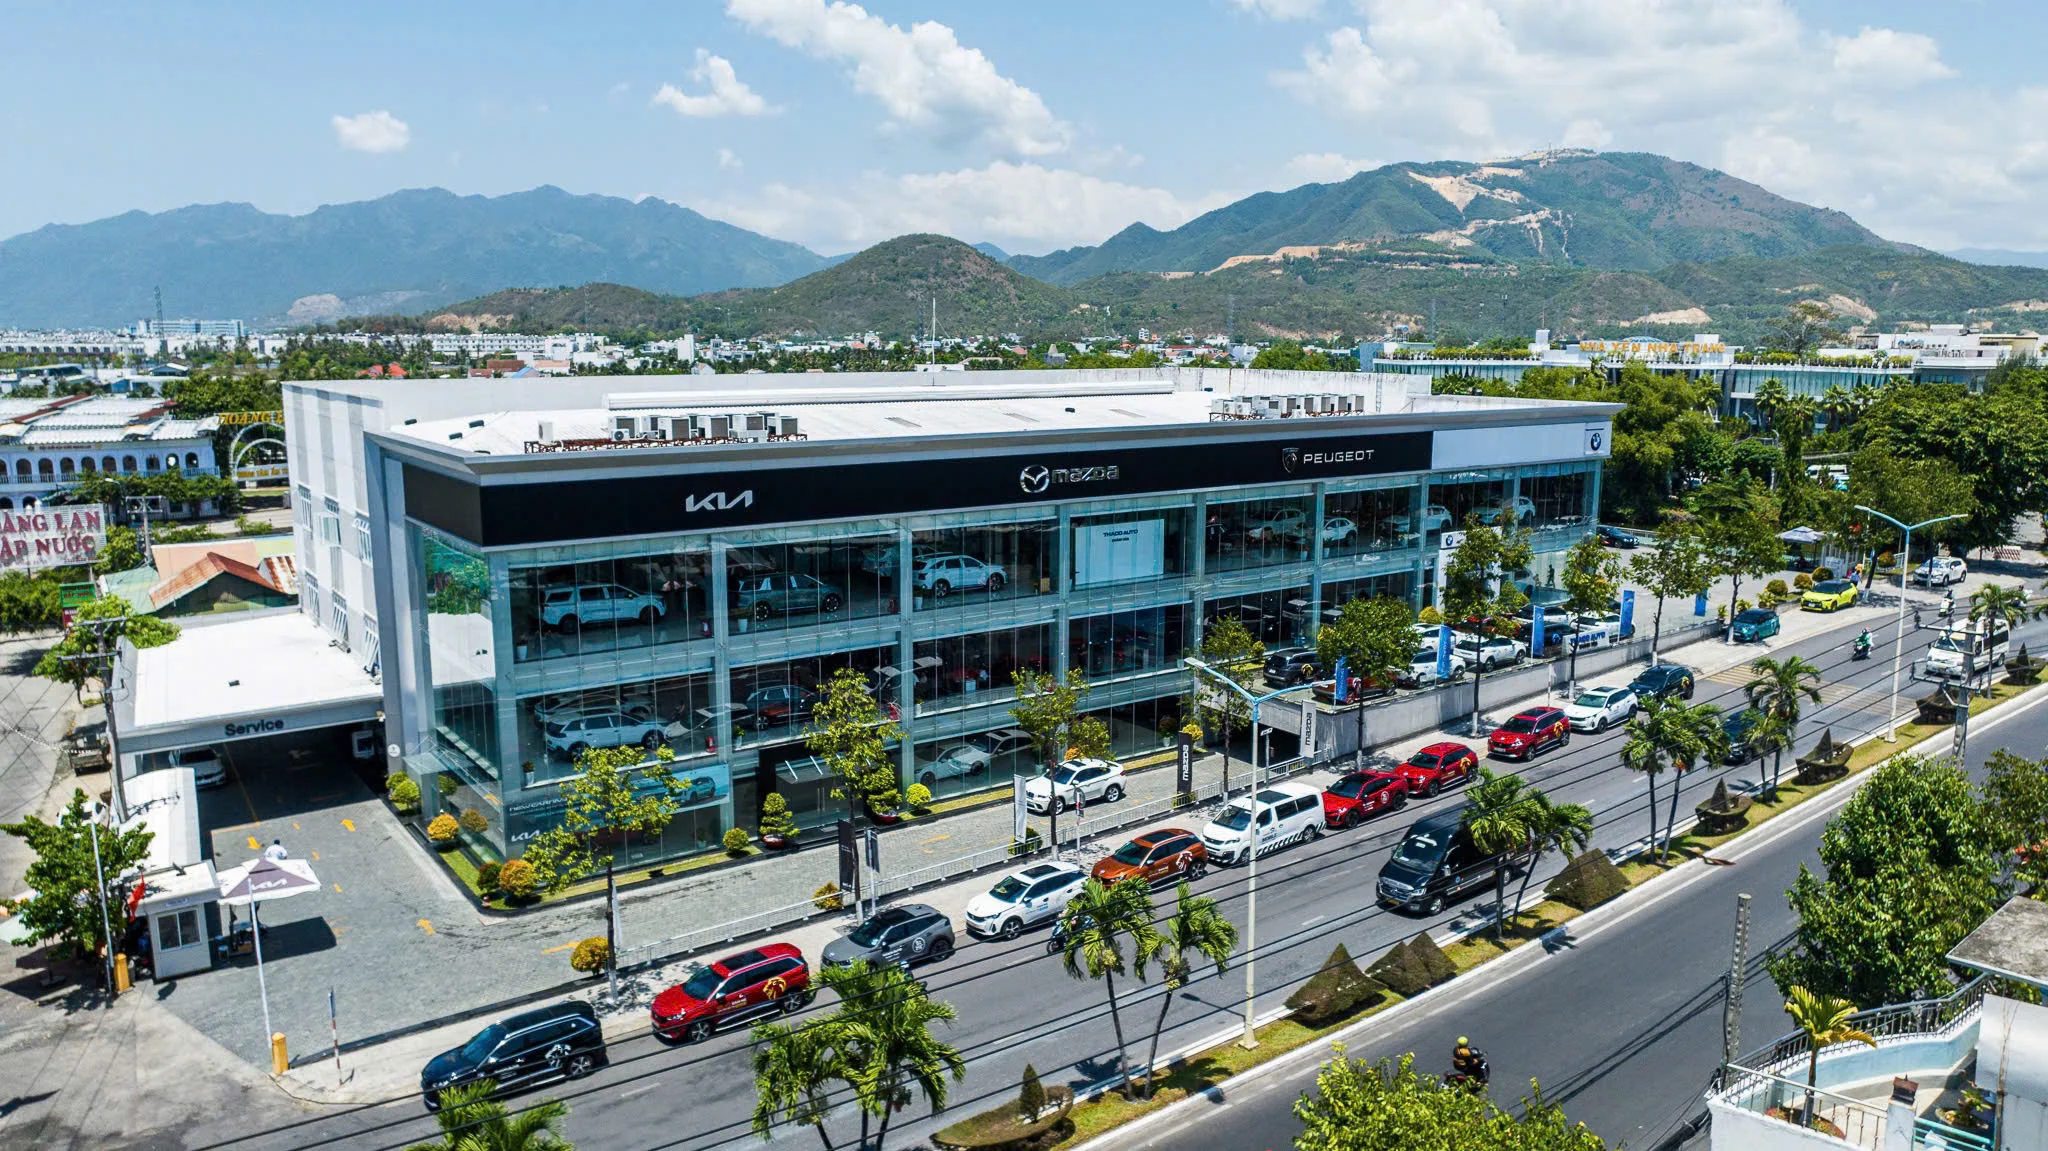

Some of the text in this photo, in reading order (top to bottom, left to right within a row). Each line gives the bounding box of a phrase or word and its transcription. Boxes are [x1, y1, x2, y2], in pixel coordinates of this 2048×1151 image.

[1303, 449, 1375, 464] PEUGEOT
[1051, 465, 1120, 484] mazda
[685, 489, 753, 512] KIA
[225, 720, 285, 737] Service
